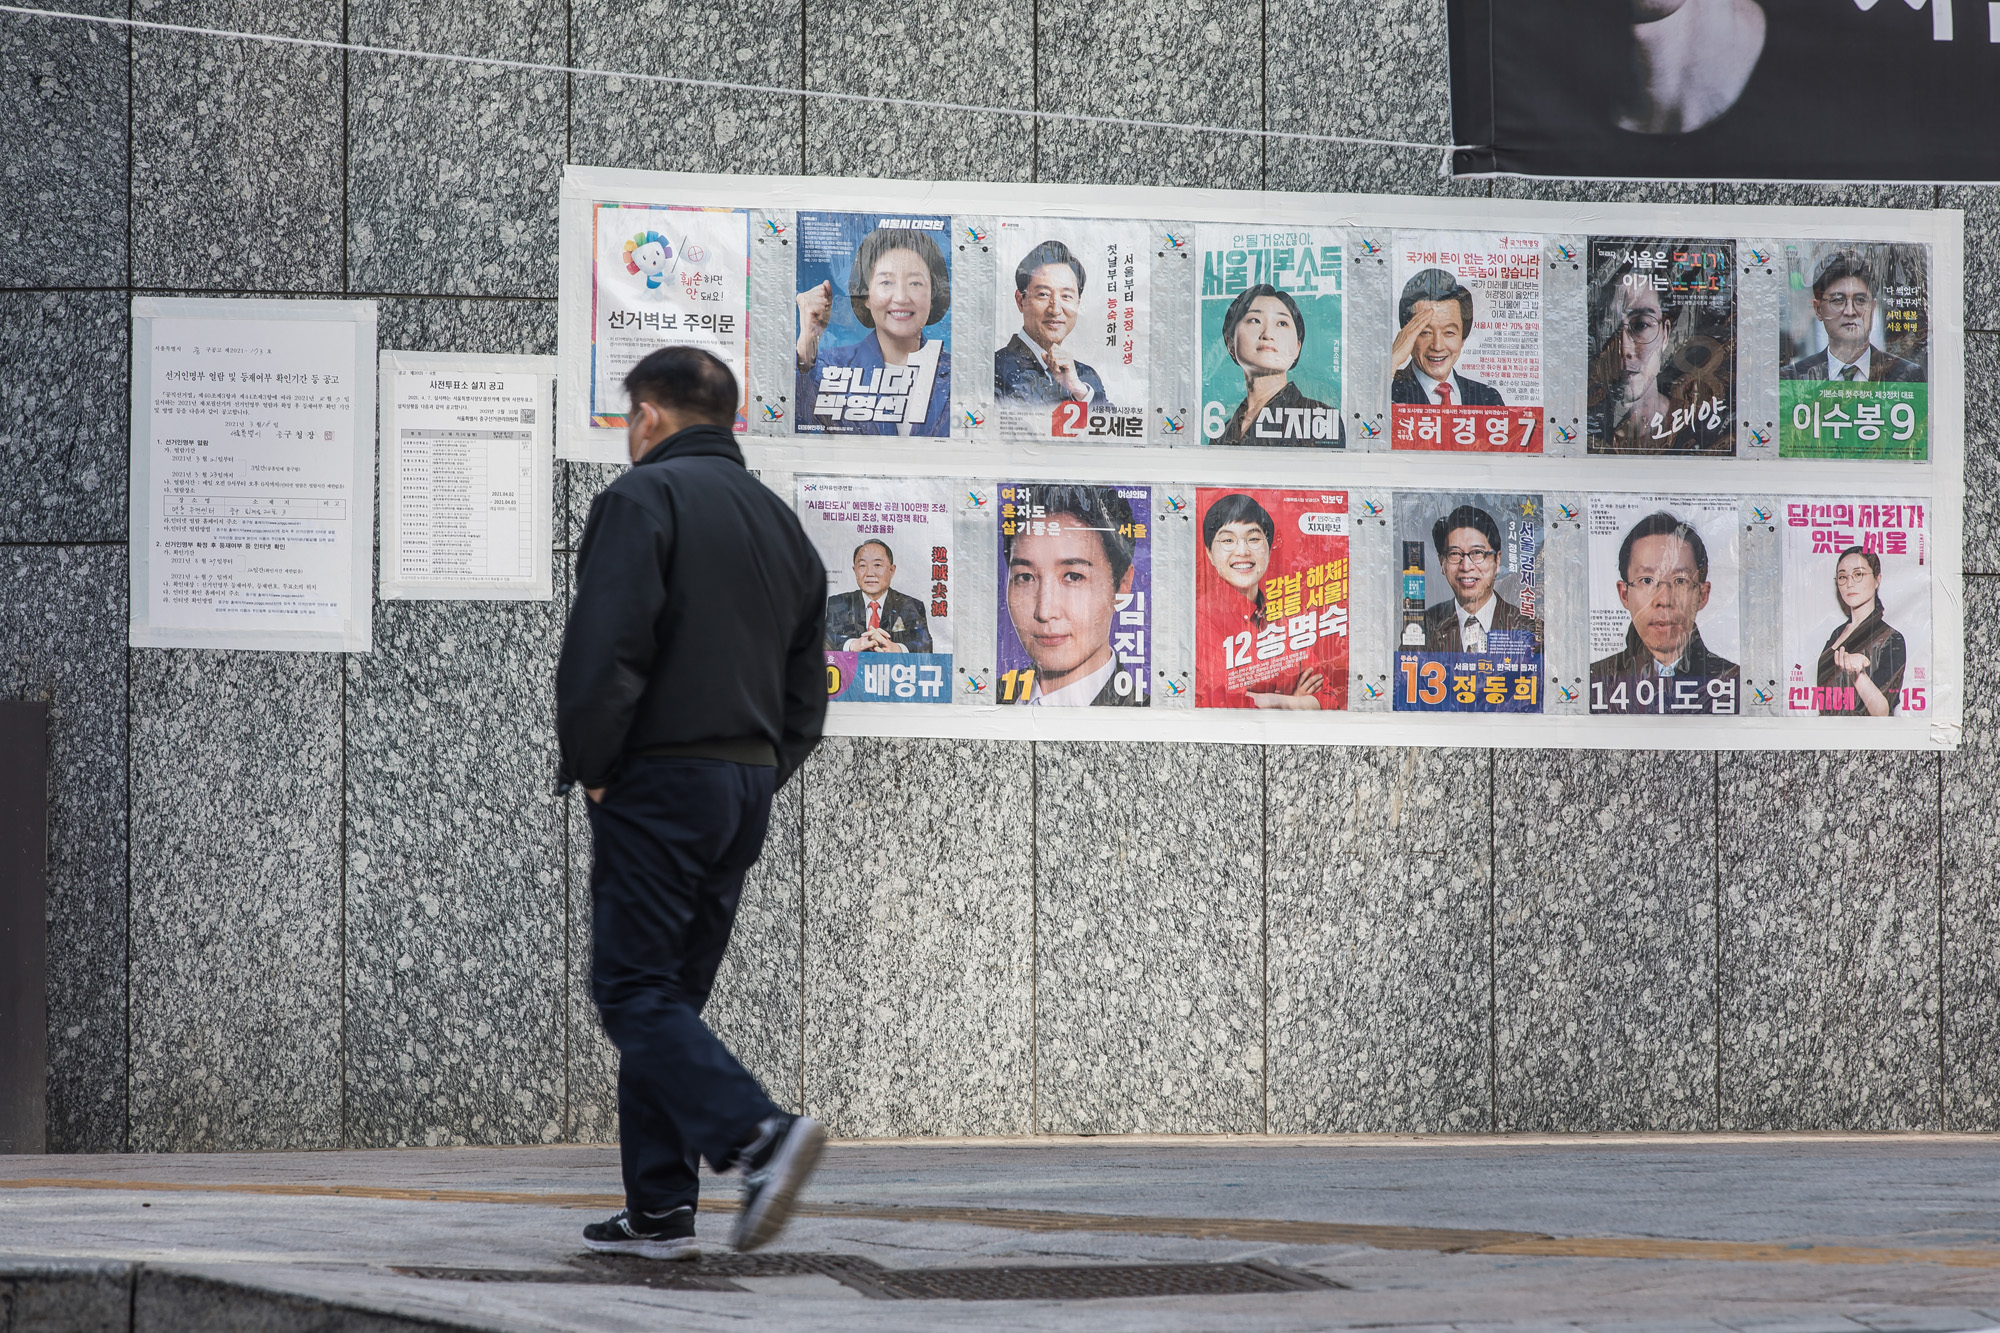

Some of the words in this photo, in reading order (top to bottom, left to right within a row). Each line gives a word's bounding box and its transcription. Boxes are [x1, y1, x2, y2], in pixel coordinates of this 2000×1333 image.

[878, 218, 910, 229] 서울시
[911, 220, 945, 231] 대전환
[1106, 244, 1117, 293] 첫날부터
[1406, 252, 1437, 264] 국가에
[1440, 253, 1460, 265] 돈이
[1464, 253, 1484, 265] 없는
[1488, 254, 1507, 265] 것이
[1511, 254, 1540, 266] 아니라
[1623, 251, 1669, 269] 서울은
[1673, 252, 1725, 270] 무지개
[680, 272, 723, 287] 훼손하면
[1124, 254, 1134, 302] 서울부터
[1202, 246, 1342, 296] 서울기본소득
[1458, 266, 1497, 279] 도둑놈이
[1501, 267, 1539, 280] 많습니다
[1623, 273, 1669, 291] 이기는
[686, 288, 697, 300] 안
[700, 291, 724, 302] 돼요!
[1471, 280, 1486, 289] 국가
[1488, 281, 1508, 289] 미래를
[1510, 282, 1539, 290] 내다보는
[1486, 290, 1514, 299] 허경영이
[1490, 300, 1497, 309] 그
[1499, 300, 1520, 309] 나물에
[1523, 301, 1530, 309] 그
[1532, 301, 1539, 310] 밥
[1492, 310, 1506, 319] 이제
[1886, 311, 1901, 320] 서민
[1903, 311, 1918, 320] 행복
[608, 311, 678, 331] 선거벽보
[683, 313, 735, 334] 주의문
[1106, 298, 1117, 347] 능숙하게
[1495, 322, 1508, 330] 예산
[1887, 322, 1902, 332] 서울
[1122, 307, 1134, 365] 공정·상생
[165, 370, 205, 382] 선거인명부
[209, 371, 225, 382] 열람
[229, 372, 236, 383] 및
[241, 372, 272, 383] 등재여부
[276, 373, 308, 384] 확인기간
[311, 374, 320, 385] 등
[323, 375, 340, 385] 공고
[429, 380, 469, 390] 사전투표소
[471, 381, 486, 391] 설치
[489, 382, 504, 391] 공고
[818, 366, 915, 395] 합니다
[906, 340, 944, 424] 1
[1819, 390, 1844, 398] 기본소득
[1845, 390, 1852, 399] 첫
[814, 394, 906, 423] 박영선
[1064, 404, 1081, 434] 2
[1092, 406, 1143, 415] 서울특별시장후보
[1651, 396, 1727, 440] 오태양
[1088, 416, 1143, 438] 오세훈
[1203, 401, 1226, 439] 6
[1256, 407, 1340, 440] 신지혜
[1418, 416, 1509, 445] 허경영
[1518, 418, 1537, 447] 7
[1793, 402, 1885, 441] 이수봉
[1890, 402, 1915, 441] 9
[1002, 488, 1031, 503] 여자
[1118, 490, 1147, 500] 여성의당
[1321, 495, 1343, 505] 진보당
[823, 512, 860, 521] 메디컬시티
[862, 513, 879, 523] 조성,
[882, 514, 911, 523] 복지정책
[913, 514, 929, 524] 확대,
[853, 502, 882, 511] 에덴동산
[884, 502, 899, 511] 공원
[901, 503, 929, 513] 100만평
[932, 504, 948, 513] 조성,
[1002, 504, 1046, 519] 혼자도
[1788, 504, 1854, 527] 당신의
[1858, 504, 1924, 529] 자리가
[857, 525, 894, 534] 예산효율화
[1002, 521, 1061, 536] 살기좋은
[1118, 524, 1147, 538] 서울
[1308, 524, 1341, 532] 지지후보
[1520, 521, 1535, 554] 서울
[1812, 530, 1855, 554] 있는
[1862, 531, 1907, 555] 서울
[1266, 572, 1302, 601] 강남
[1307, 558, 1348, 589] 해체!
[1520, 556, 1535, 587] 경제
[1266, 594, 1302, 622] 평등
[1307, 580, 1348, 611] 서울!
[1113, 592, 1147, 702] 김진아
[1223, 632, 1252, 670] 12
[1257, 604, 1348, 661] 송명숙
[826, 664, 842, 694] 0
[864, 664, 944, 698] 배영규
[1002, 670, 1035, 701] 11
[1400, 661, 1447, 705] 13
[1453, 676, 1537, 705] 정동희
[1591, 682, 1630, 710] 14
[1636, 677, 1736, 714] 이도엽
[1789, 687, 1855, 710] 신지예
[1902, 688, 1926, 711] 15
